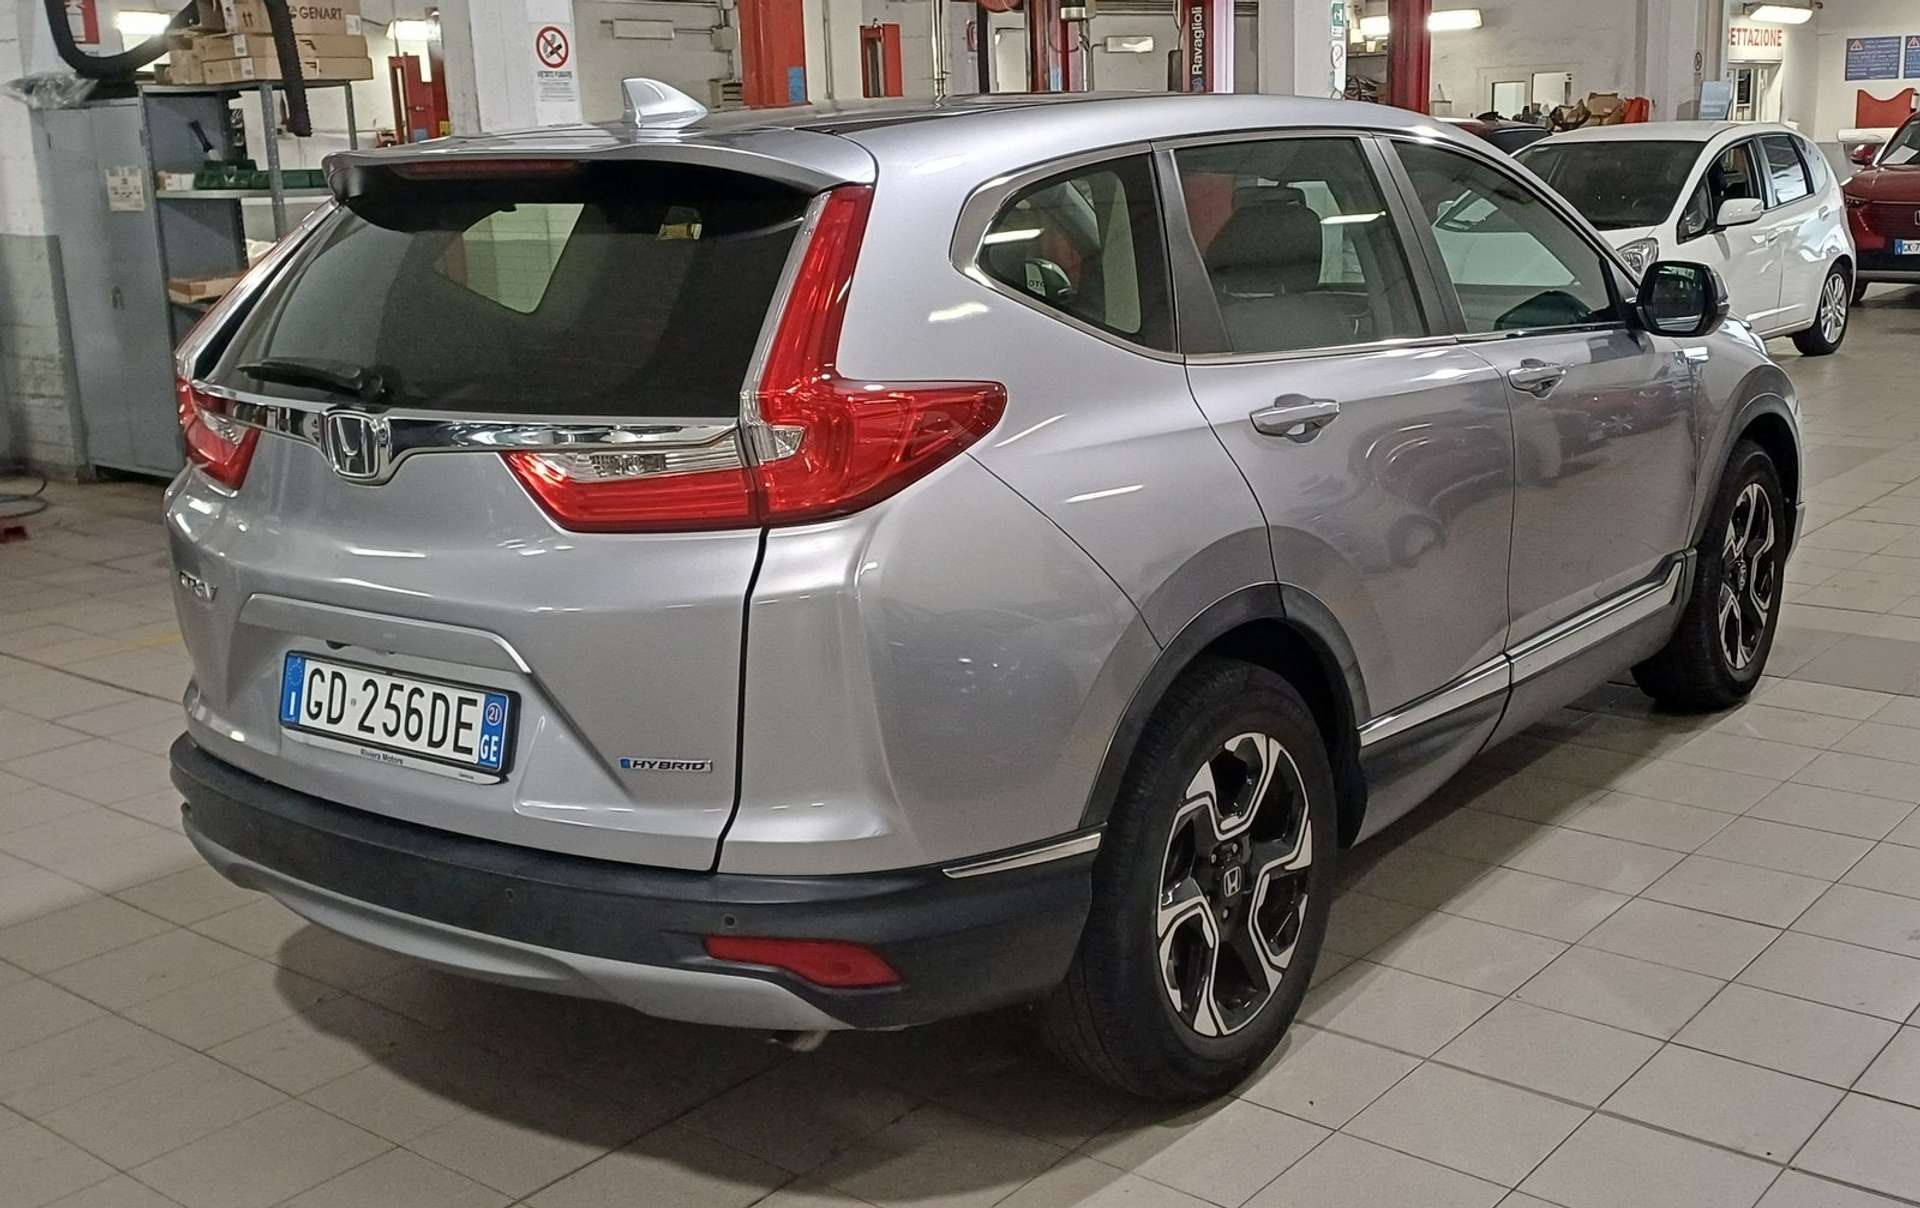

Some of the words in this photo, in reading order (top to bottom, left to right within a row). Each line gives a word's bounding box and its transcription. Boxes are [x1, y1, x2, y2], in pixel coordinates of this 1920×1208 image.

[1191, 6, 1204, 75] Ravaglioli
[1728, 27, 1783, 47] ETTAZIONE
[480, 734, 499, 762] GE
[632, 760, 706, 771] HYBRID
